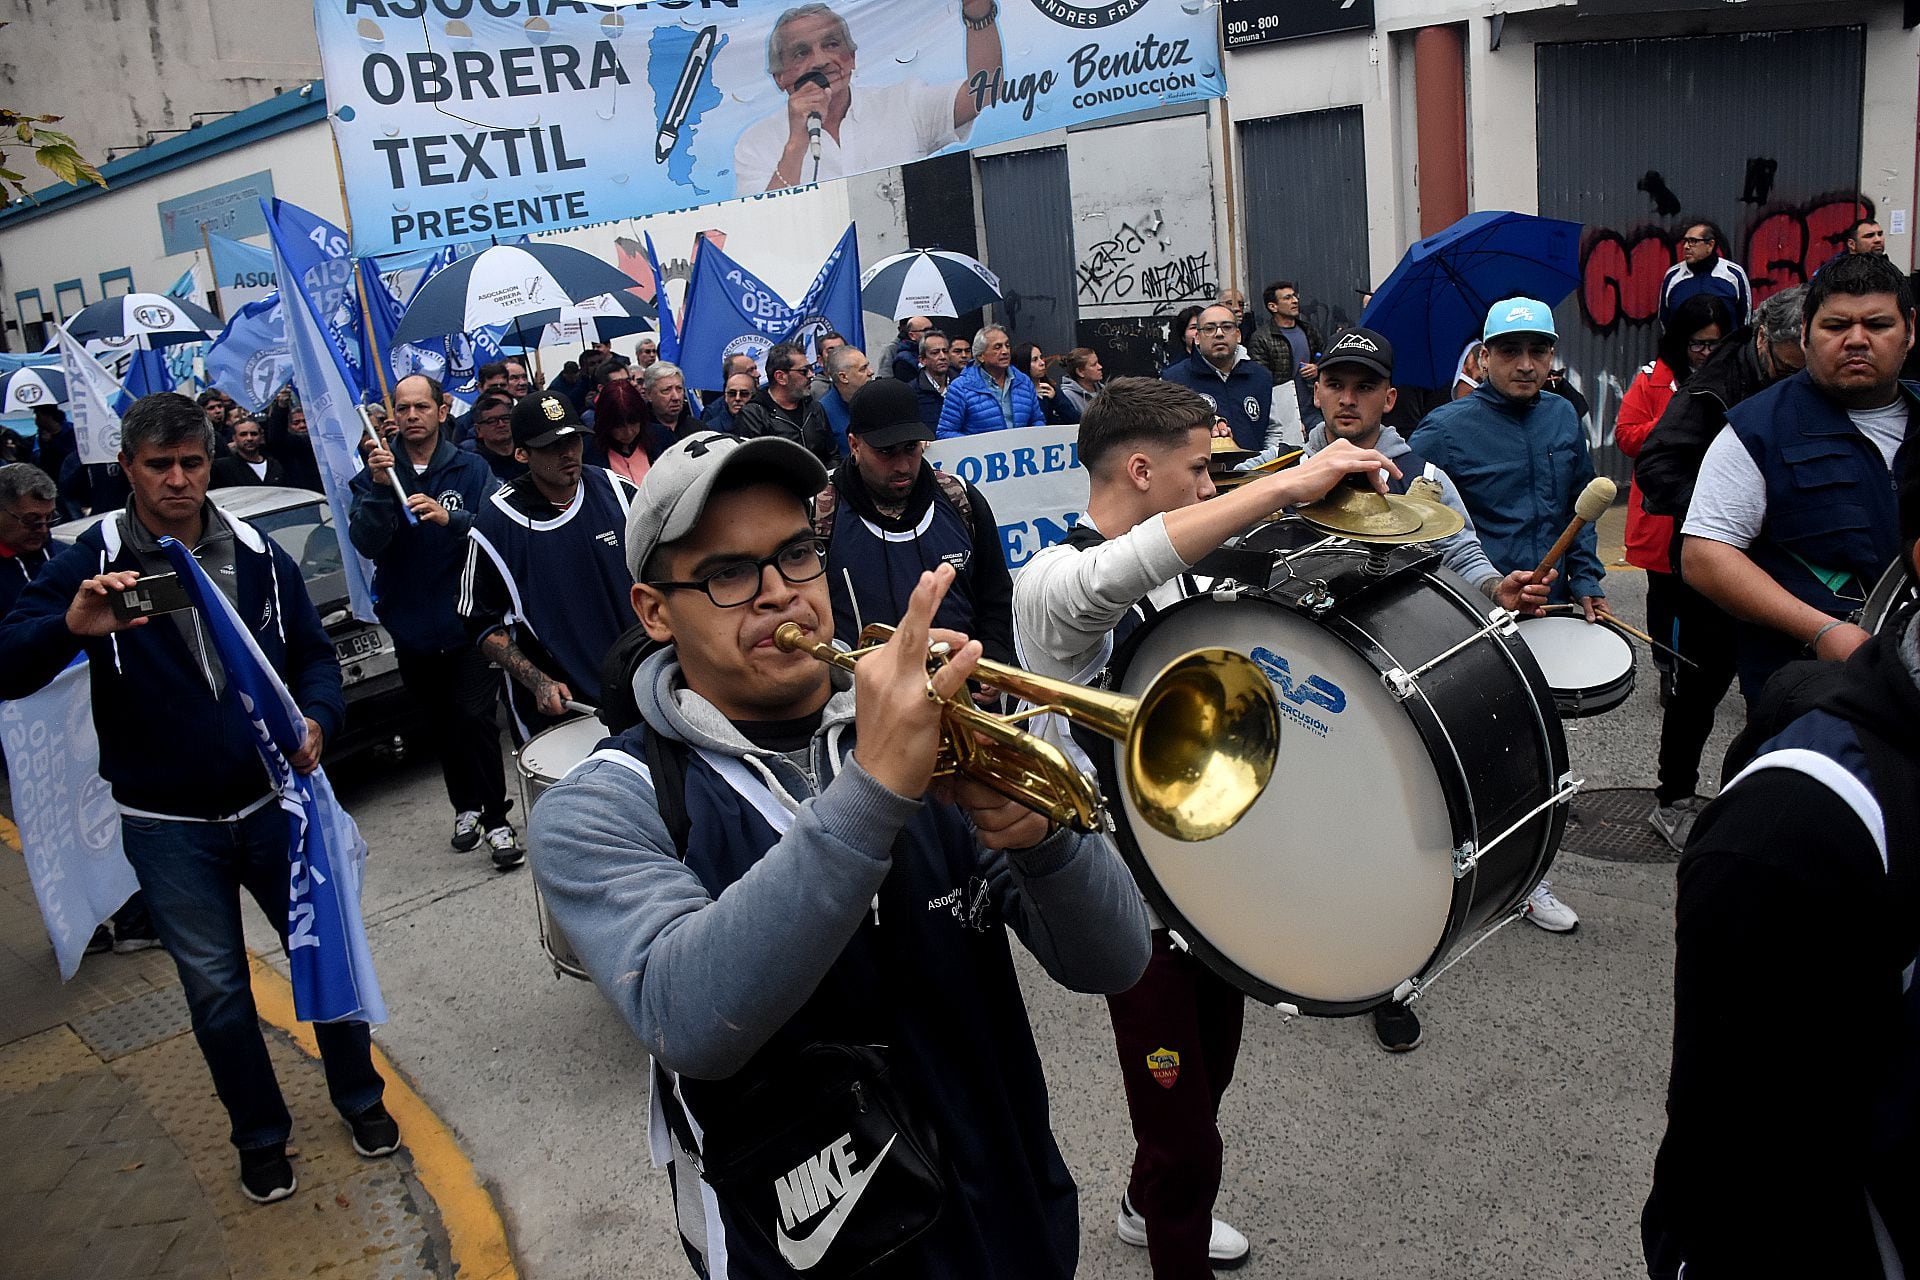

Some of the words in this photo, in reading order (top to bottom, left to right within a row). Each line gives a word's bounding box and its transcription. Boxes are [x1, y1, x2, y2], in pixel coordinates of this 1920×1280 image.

[1228, 21, 1248, 34] 900
[1258, 15, 1279, 29] 800
[1229, 34, 1260, 44] Comuna
[1261, 31, 1266, 39] 1
[362, 40, 631, 105] OBRERA
[969, 67, 1059, 121] Hugo
[1067, 33, 1193, 88] Benitez
[1072, 72, 1196, 109] CONDUCCIÓN
[373, 124, 587, 189] TEXTIL
[392, 190, 589, 244] PRESENTE
[443, 497, 458, 511] 62
[353, 632, 380, 653] 893
[1152, 1070, 1178, 1078] ROMA
[775, 1133, 863, 1231] NIKE
